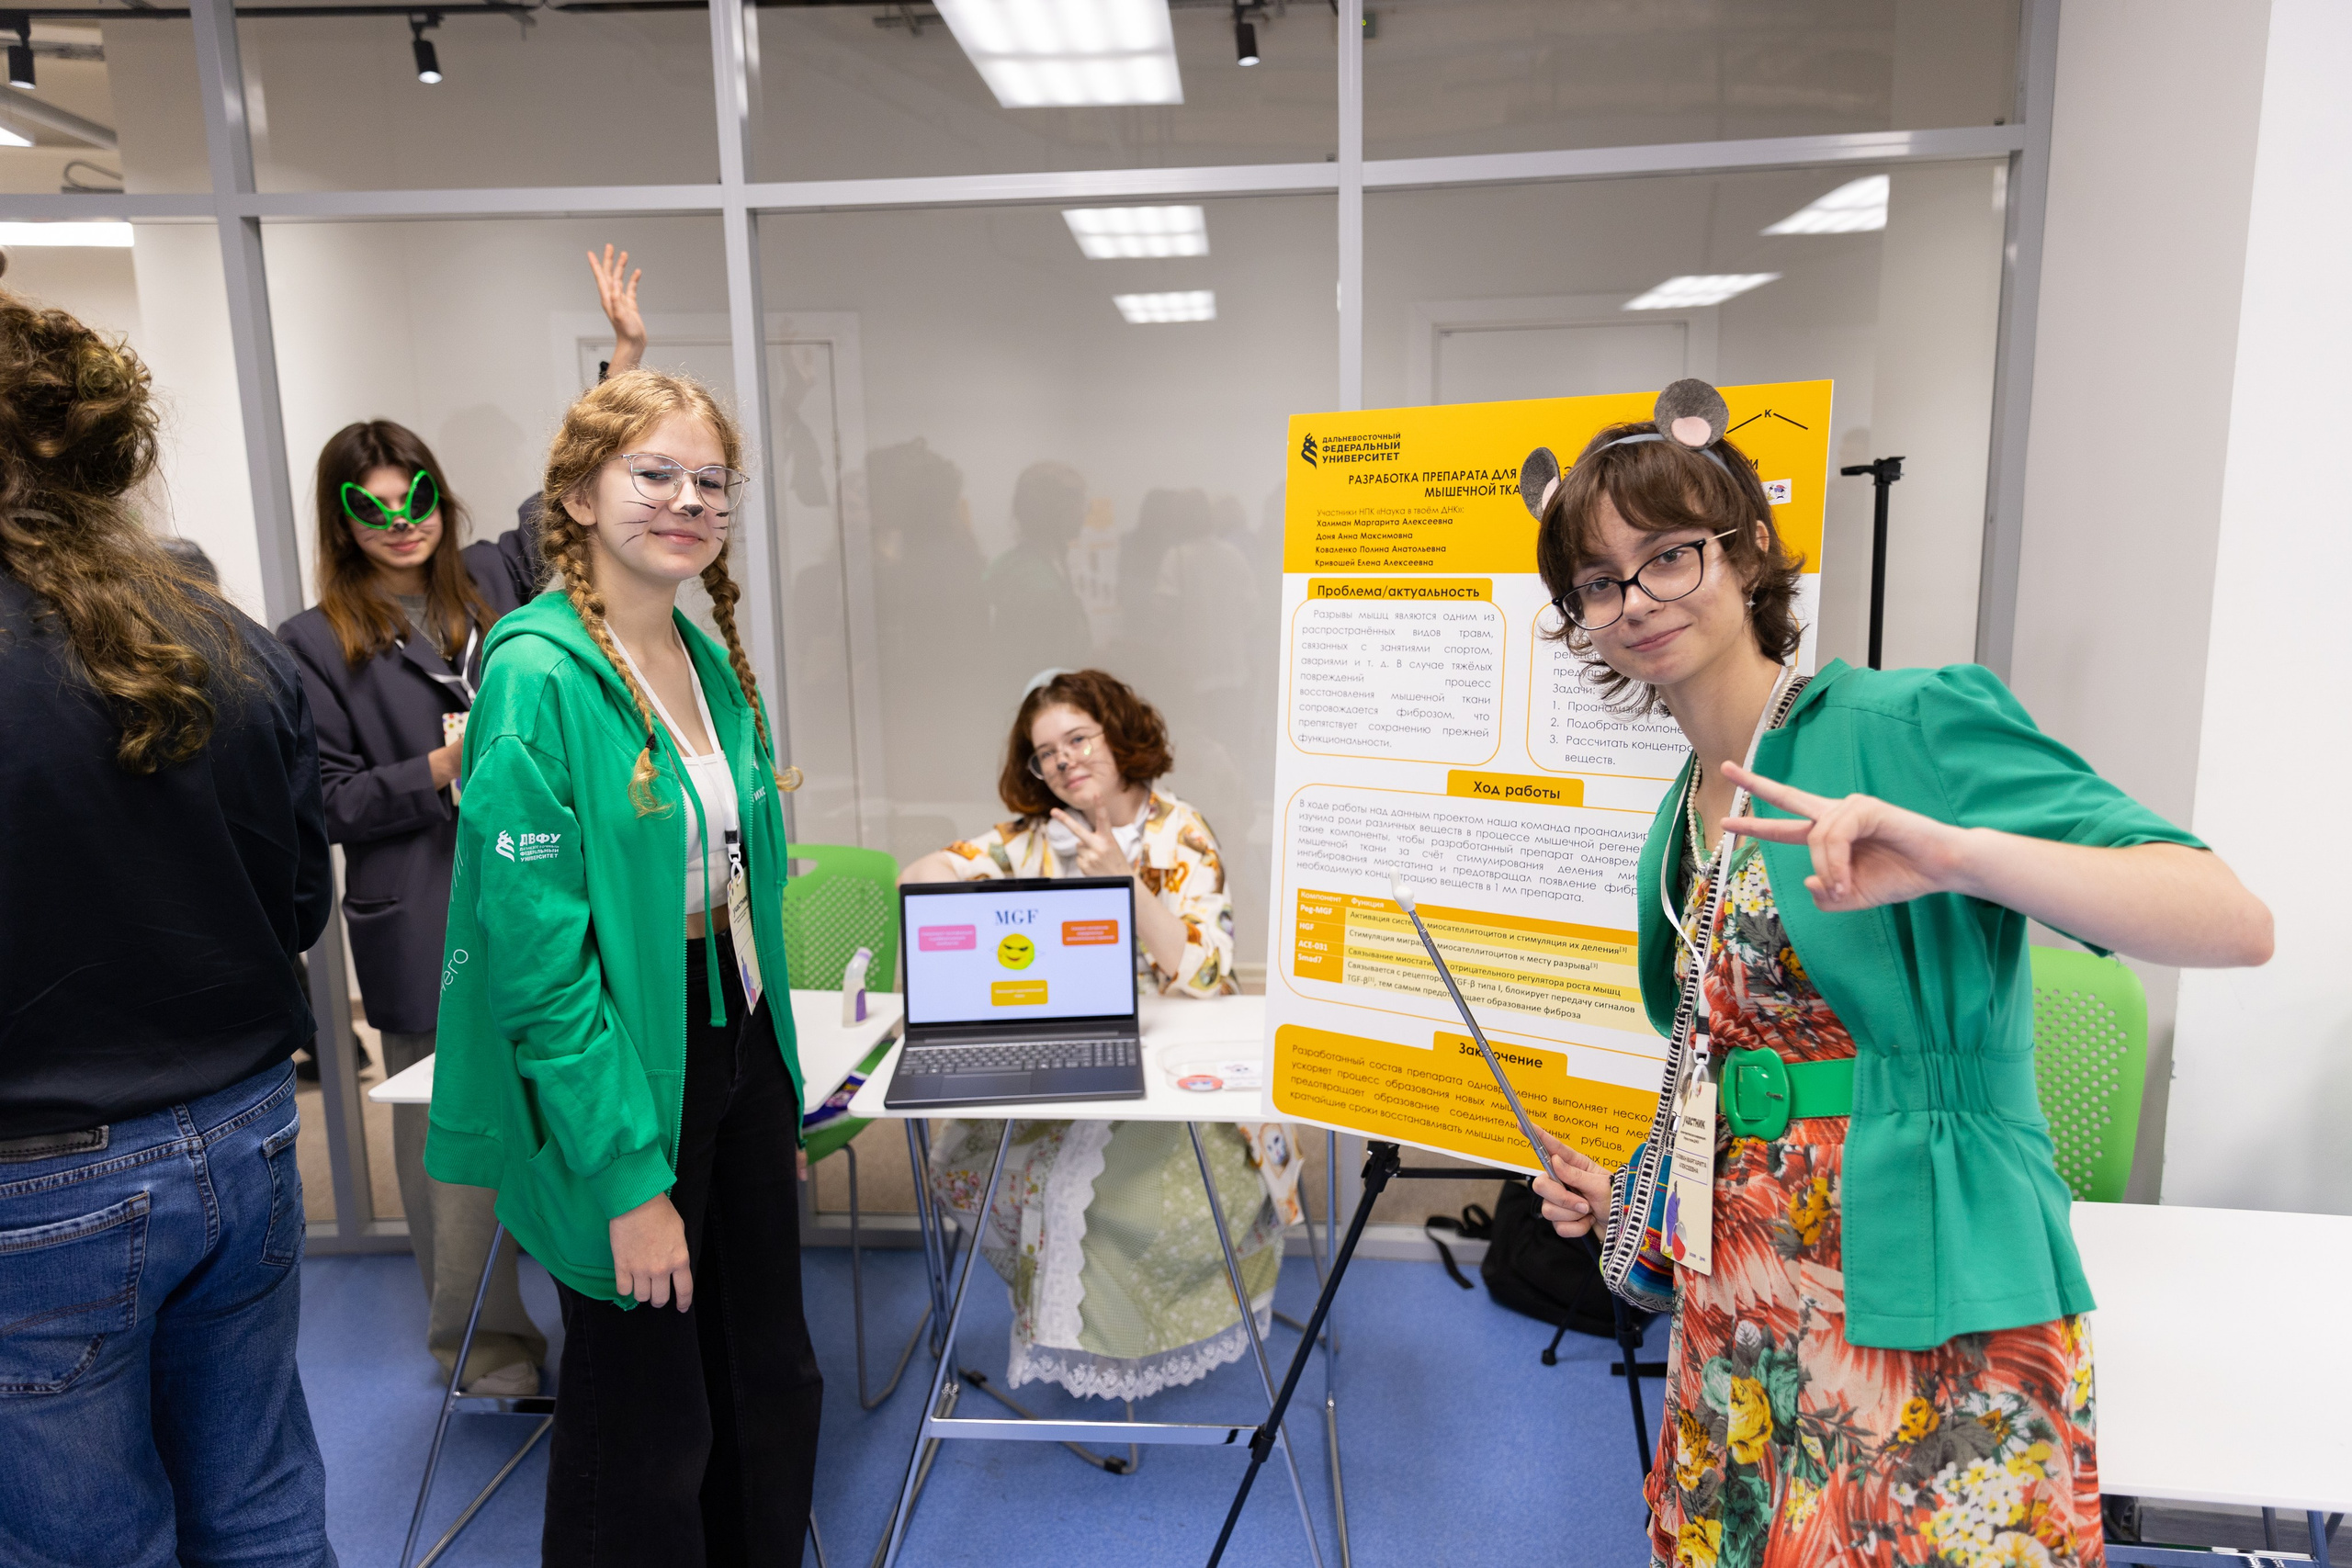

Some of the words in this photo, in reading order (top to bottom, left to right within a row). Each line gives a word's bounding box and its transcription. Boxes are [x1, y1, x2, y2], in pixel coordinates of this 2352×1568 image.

[1322, 433, 1400, 444] ДАЛЬНЕВОСТОЧНЫЙ
[1322, 441, 1400, 452] ФЕДЕРАЛЬНЫЙ
[1322, 452, 1400, 464] УНИВЕРСИТЕТ
[1349, 472, 1419, 484] РАЗРАБОТКА
[1422, 470, 1488, 482] ПРЕПАРАТА
[1492, 468, 1517, 480] ДЛЯ
[1424, 483, 1496, 498] МЫШЕЧНОЙ
[1499, 484, 1521, 495] ТКА
[1317, 509, 1356, 517] Участники
[1359, 508, 1374, 516] НПК
[1354, 518, 1400, 527] Маргарита
[1360, 531, 1413, 540] Максимовна
[1316, 546, 1357, 554] Коваленко
[1392, 545, 1446, 553] Анатольевна
[1384, 558, 1433, 567] Алексеевна
[1317, 585, 1479, 598] Проблема/актуальность
[1314, 610, 1352, 619] Разрывы
[1359, 612, 1388, 621] мышц
[1443, 613, 1476, 621] одним
[1302, 626, 1395, 636] распространённых
[1413, 629, 1441, 637] видов
[1460, 629, 1493, 638] травм,
[1302, 641, 1348, 650] связанных
[1380, 644, 1430, 653] занятиями
[1444, 646, 1492, 655] спортом,
[1301, 658, 1347, 667] авариями
[1396, 660, 1402, 668] В
[1409, 661, 1444, 671] случае
[1452, 660, 1492, 671] тяжёлых
[1301, 672, 1364, 682] повреждений
[1445, 679, 1491, 688] процесс
[1300, 689, 1374, 698] восстановления
[1391, 692, 1444, 703] мышечной
[1463, 695, 1490, 704] ткани
[1553, 684, 1595, 694] Задачи:
[1299, 705, 1378, 715] сопровождается
[1396, 707, 1454, 719] фиброзом,
[1474, 713, 1489, 721] что
[1553, 701, 1560, 710] 1.
[1298, 719, 1357, 729] препятствует
[1369, 723, 1430, 734] сохранению
[1442, 727, 1489, 738] прежней
[1551, 718, 1559, 728] 2.
[1567, 718, 1628, 731] Подобрать
[1632, 724, 1683, 733] компоне
[1298, 734, 1392, 747] функциональности.
[1550, 735, 1558, 744] 3.
[1566, 736, 1628, 749] Рассчитать
[1566, 754, 1616, 765] веществ.
[1474, 782, 1499, 795] Ход
[1506, 785, 1560, 799] работы
[1300, 799, 1304, 807] В
[1307, 801, 1329, 810] ходе
[1332, 802, 1367, 813] работы
[1391, 809, 1430, 819] данным
[1433, 813, 1484, 825] проектом
[1487, 819, 1517, 828] наша
[1521, 820, 1570, 833] команда
[1299, 813, 1334, 824] изучила
[1338, 816, 1362, 826] роли
[1366, 818, 1415, 830] различных
[1419, 824, 1462, 836] веществ
[1476, 829, 1530, 841] процессе
[1534, 836, 1594, 849] мышечной
[520, 833, 561, 846] ДВФУ
[1298, 825, 1324, 834] такие
[1330, 829, 1390, 841] компоненты,
[1396, 833, 1425, 844] чтобы
[1431, 839, 1512, 853] разработанный
[1521, 847, 1573, 861] препарат
[1298, 839, 1348, 849] мышечной
[1360, 844, 1386, 852] ткани
[1422, 849, 1443, 859] счёт
[1456, 854, 1544, 871] стимулирования
[1557, 865, 1603, 877] деления
[1297, 850, 1367, 863] ингибирования
[1374, 858, 1432, 871] миостатина
[1453, 867, 1532, 883] предотвращал
[1540, 875, 1596, 890] появление
[1296, 862, 1362, 875] необходимую
[1441, 878, 1483, 890] веществ
[1502, 886, 1517, 894] мл
[1521, 887, 1584, 903] препарата.
[1301, 891, 1341, 903] Компонент
[1351, 897, 1385, 908] Функция
[1300, 904, 1332, 915] Peg-MGF
[995, 909, 1039, 926] MGF
[1299, 922, 1315, 931] HGF
[1351, 911, 1390, 923] Активация
[1427, 922, 1507, 939] миосателлитоцитов
[1517, 935, 1566, 948] стимуляция
[1298, 942, 1328, 952] ACE-031
[1349, 930, 1395, 942] Стимуляция
[1437, 943, 1518, 960] миосателлитоцитов
[1527, 956, 1552, 966] месту
[1298, 953, 1322, 964] Smad7
[1348, 948, 1394, 961] Связывание
[1450, 964, 1515, 979] отрицательного
[1518, 973, 1564, 987] регулятора
[1566, 981, 1590, 991] роста
[1593, 985, 1621, 997] мышц
[1348, 962, 1395, 976] Связывается
[1477, 981, 1498, 991] типа
[1506, 986, 1549, 999] блокирует
[1552, 993, 1592, 1008] передачу
[1594, 1000, 1635, 1013] сигналов
[1378, 981, 1392, 989] тем
[1395, 982, 1420, 993] самым
[1487, 997, 1541, 1012] образование
[1544, 1006, 1581, 1019] фиброза
[1293, 1044, 1364, 1066] Разработанный
[1369, 1060, 1402, 1074] состав
[1408, 1068, 1462, 1086] препарата
[1553, 1097, 1608, 1114] выполняет
[1292, 1062, 1331, 1075] ускоряет
[1338, 1069, 1379, 1085] процесс
[1385, 1078, 1449, 1099] образования
[1455, 1093, 1485, 1106] новых
[1554, 1113, 1598, 1129] волокон
[1605, 1123, 1619, 1134] на
[1290, 1090, 1346, 1109] кратчайшие
[1349, 1103, 1377, 1115] сроки
[1380, 1111, 1462, 1134] восстанавливать
[1465, 1129, 1504, 1143] мышцы
[1291, 1076, 1364, 1097] предотвращает
[1374, 1091, 1440, 1112] образование
[1581, 1135, 1624, 1153] рубцов,
